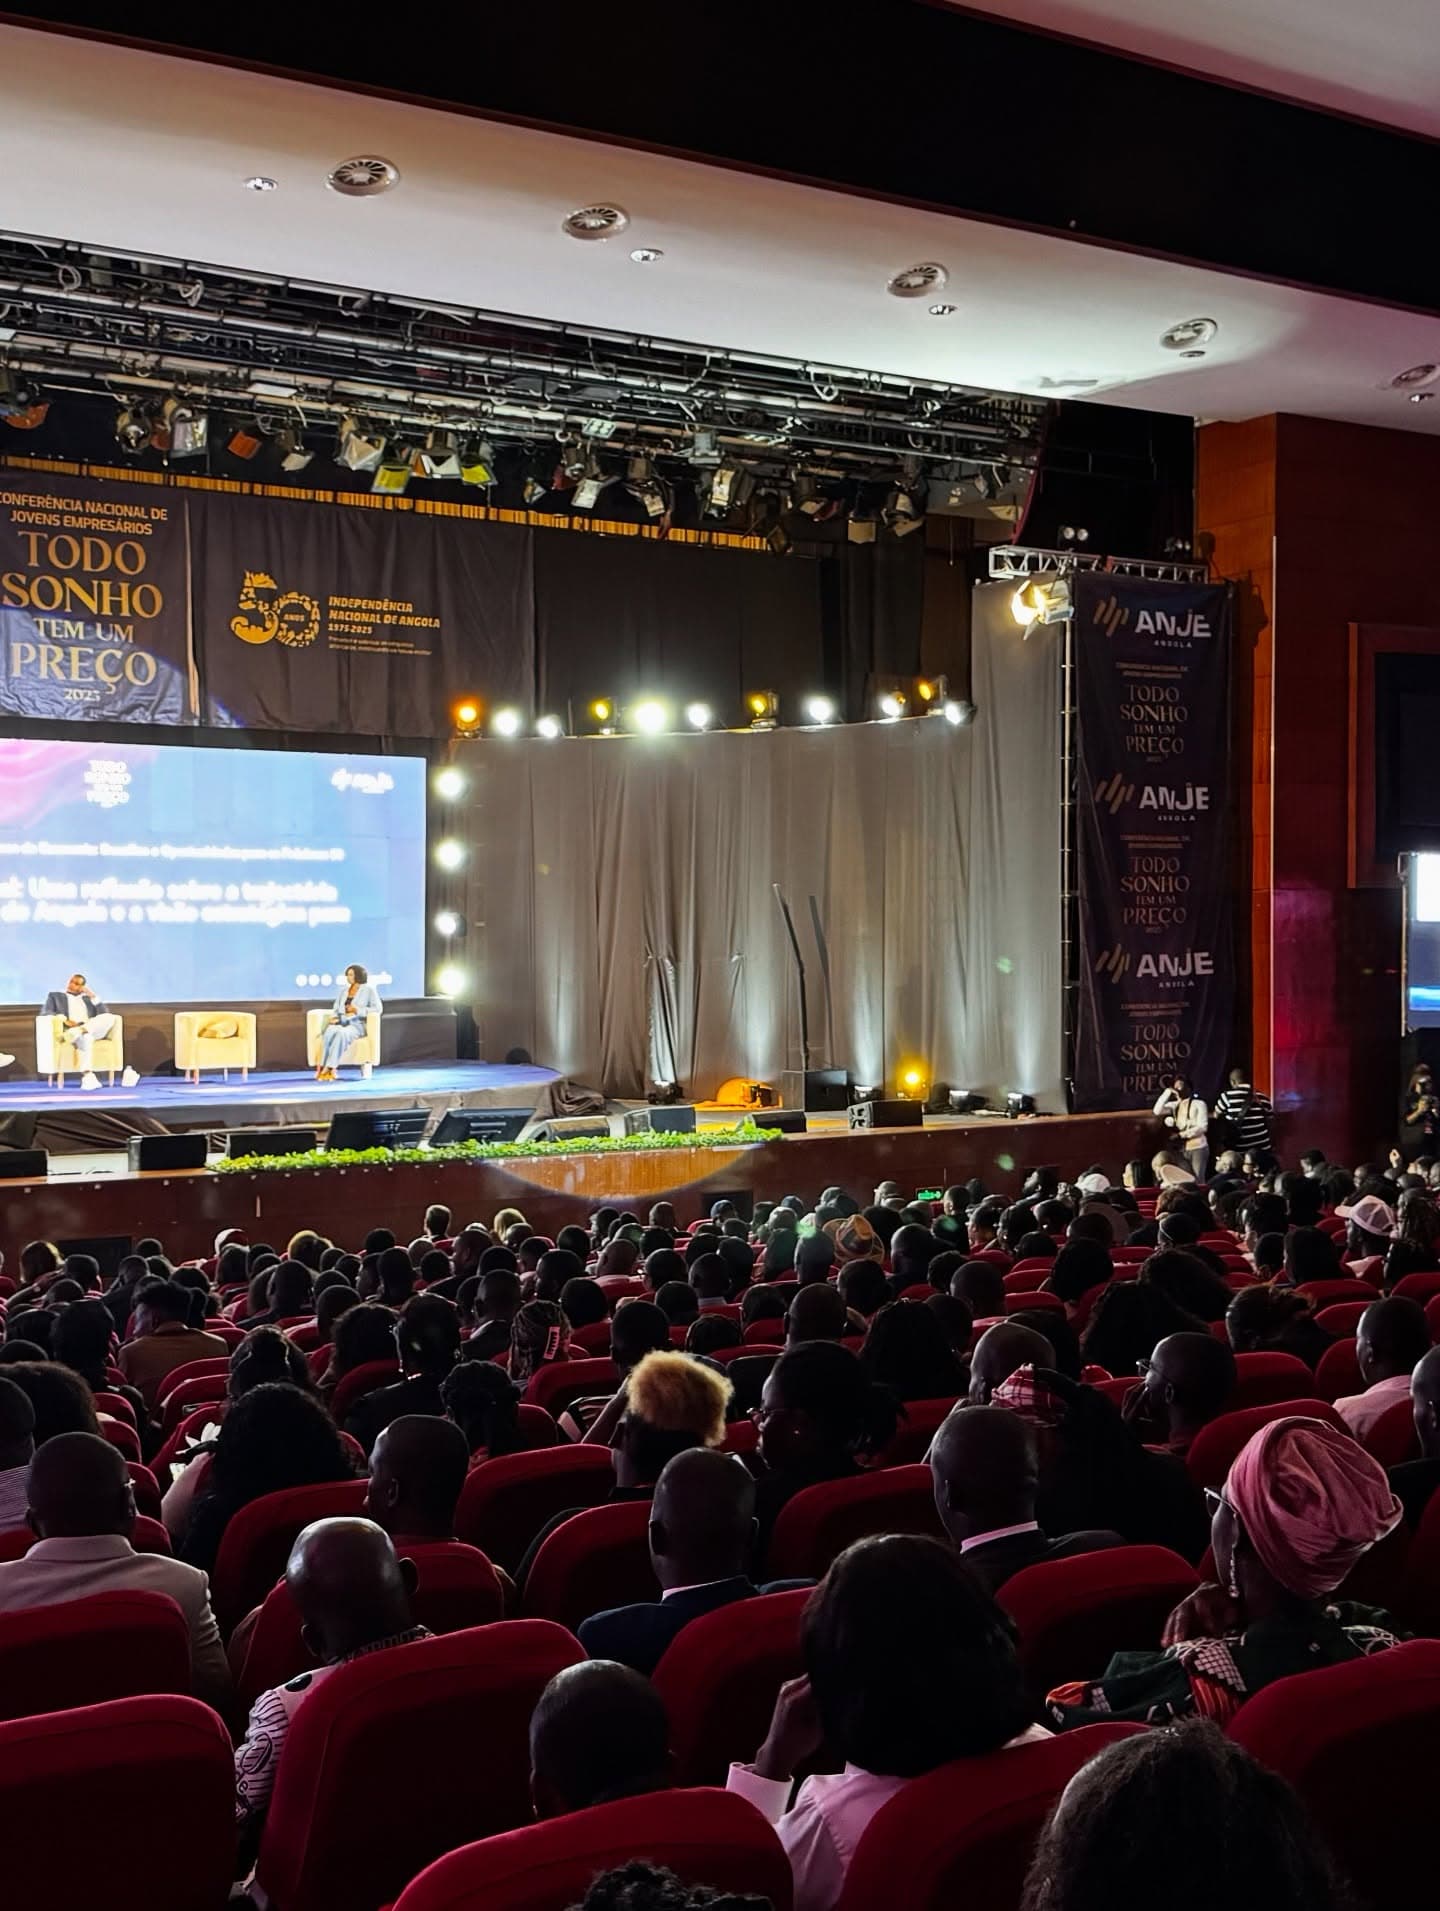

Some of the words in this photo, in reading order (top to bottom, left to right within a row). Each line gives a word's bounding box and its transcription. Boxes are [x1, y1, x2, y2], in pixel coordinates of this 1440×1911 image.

[85, 501, 149, 519] NACIONAL
[151, 507, 168, 521] DE
[10, 510, 61, 526] JOVENS
[63, 515, 153, 535] EMPRESÁRIOS
[17, 530, 147, 576] TODO
[1, 571, 163, 619] SONHO
[328, 596, 413, 613] INDEPENDÊNCIA
[328, 609, 381, 624] NACIONAL
[383, 614, 397, 625] DE
[399, 617, 441, 628] ANGOLA
[1134, 609, 1212, 638] ANJE
[33, 617, 86, 641] TEM
[96, 623, 134, 643] UM
[9, 641, 157, 695] PREÇO
[1125, 684, 1180, 702] TODO
[1119, 704, 1188, 722] SONHO
[1158, 724, 1176, 735] UM
[1138, 782, 1210, 810] ANJE
[1129, 856, 1180, 873] TODO
[1120, 876, 1190, 893] SONHO
[1123, 907, 1187, 929] PREÇO
[1136, 948, 1214, 978] ANJE
[1130, 1023, 1180, 1041] TODO
[1120, 1042, 1191, 1061] SONHO
